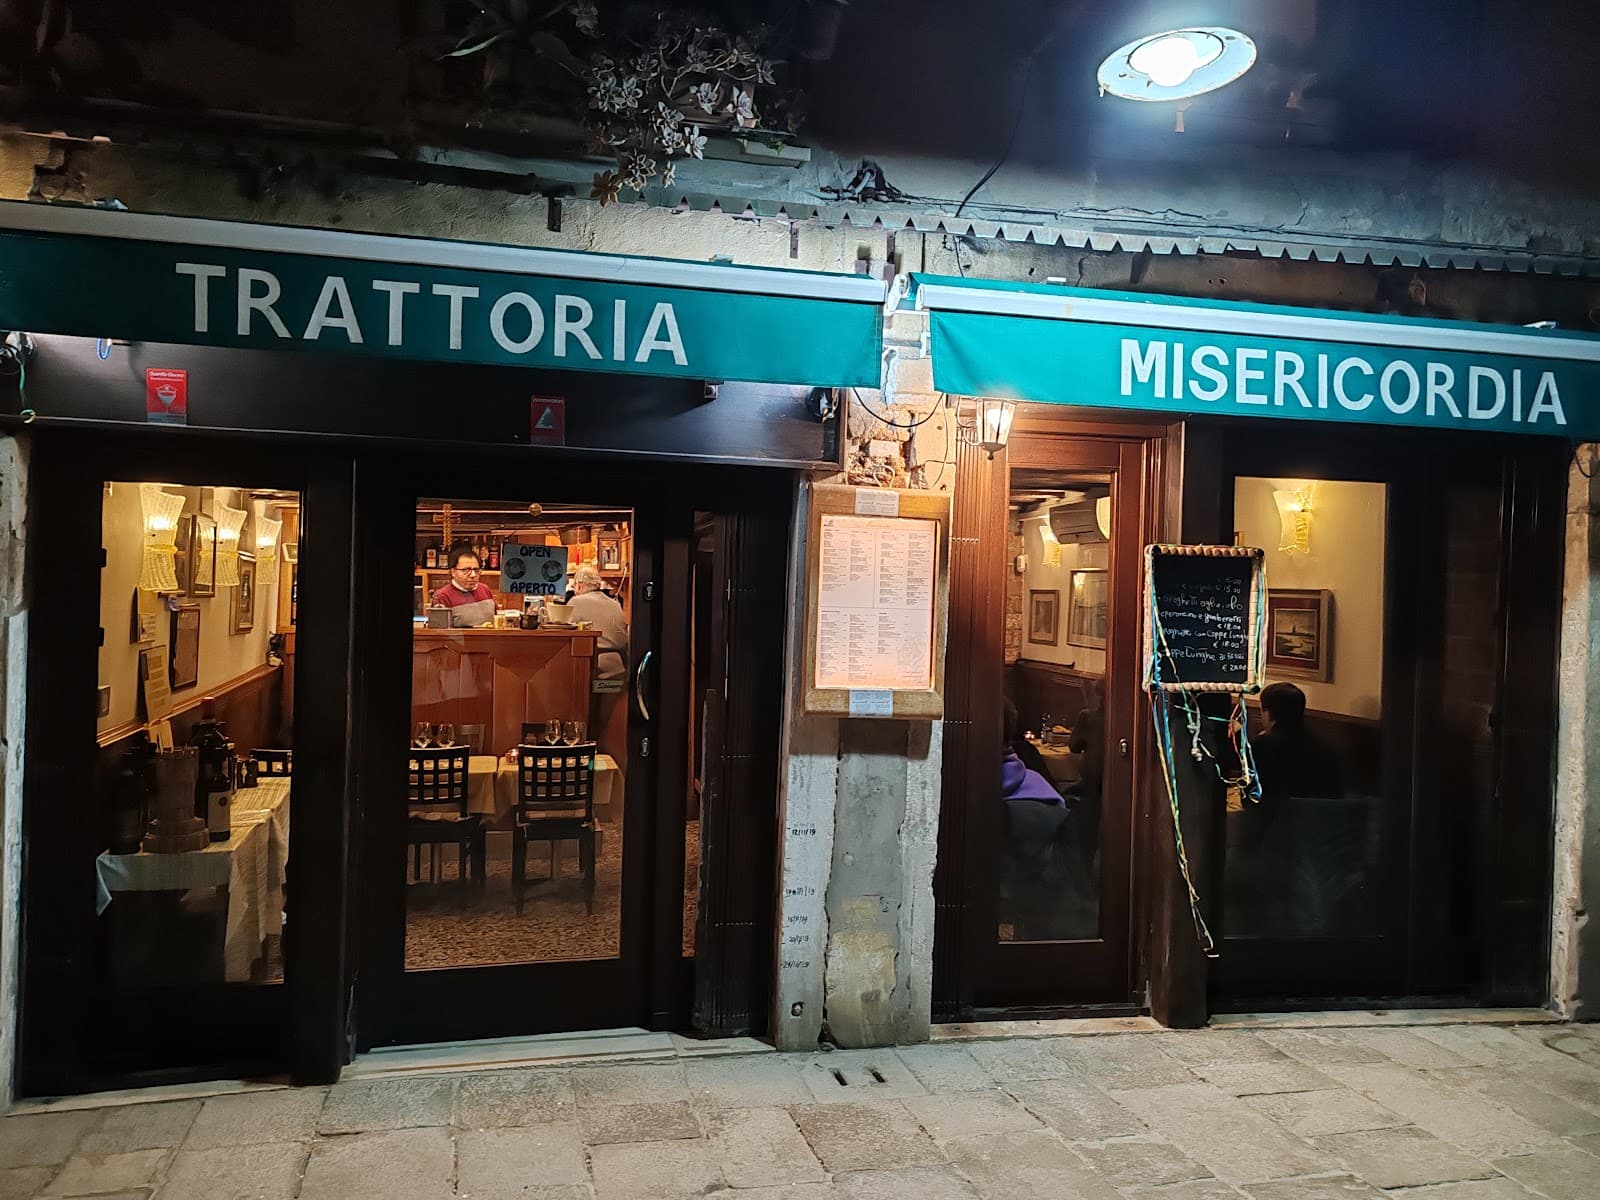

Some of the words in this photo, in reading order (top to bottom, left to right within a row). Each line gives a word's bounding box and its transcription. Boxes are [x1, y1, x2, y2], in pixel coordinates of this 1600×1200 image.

[175, 262, 689, 366] TRATTORIA
[1120, 338, 1567, 425] MISERICORDIA
[519, 546, 551, 558] OPEN
[510, 582, 556, 595] APERTO
